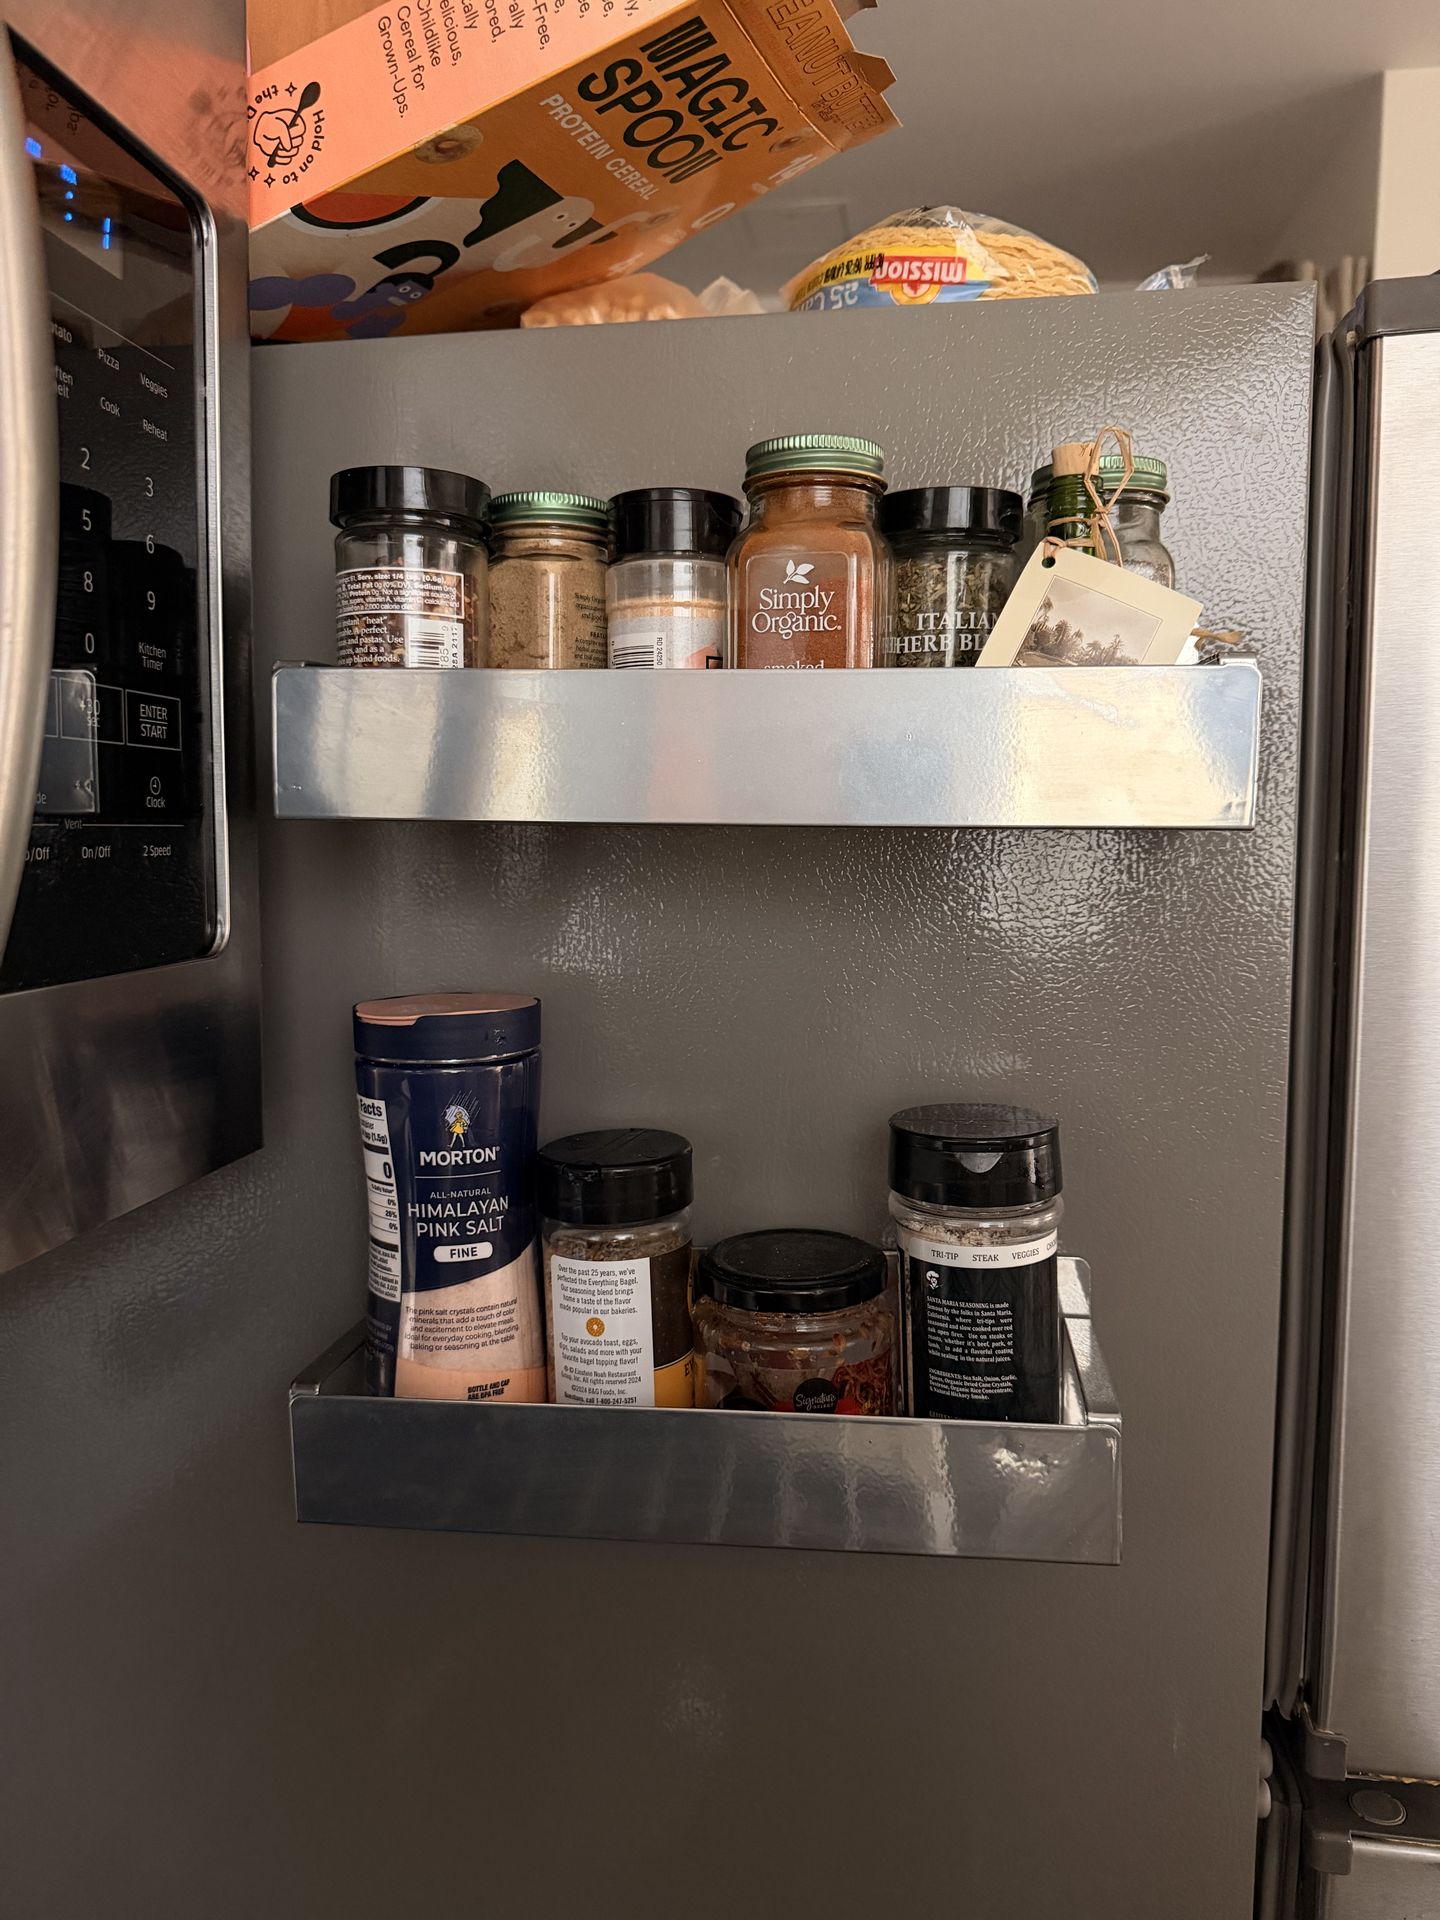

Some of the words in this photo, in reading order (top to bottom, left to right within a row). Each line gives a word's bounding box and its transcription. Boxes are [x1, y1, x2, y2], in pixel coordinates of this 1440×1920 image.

[461, 0, 478, 31] ally
[484, 0, 506, 44] ored,
[508, 0, 524, 31] ally
[416, 0, 442, 68] Childlike
[440, 0, 463, 67] elicious,
[397, 5, 422, 63] Cereal
[410, 63, 426, 92] for
[766, 0, 851, 86] EANUT
[378, 15, 409, 119] Grown-Ups.
[639, 15, 778, 151] MAGIC
[254, 84, 279, 105] the
[577, 58, 723, 184] SPOON
[311, 109, 326, 152] Hold
[539, 93, 615, 160] PROTEIN
[605, 157, 660, 201] CEREAL
[299, 154, 314, 173] on
[282, 171, 299, 185] to
[831, 281, 859, 310] 25
[97, 347, 120, 371] Pizza
[57, 383, 70, 399] elt
[139, 371, 168, 399] Veggies
[100, 396, 121, 417] Cook
[142, 418, 168, 442] Reheat
[80, 447, 91, 471] 2
[145, 476, 154, 497] 3
[82, 508, 92, 531] 5
[146, 533, 155, 554] 6
[84, 570, 94, 592] 8
[147, 590, 156, 611] 9
[758, 584, 835, 616] Simply
[361, 625, 388, 636] perfect
[751, 610, 843, 640] Organic.
[85, 632, 95, 654] 0
[359, 636, 385, 647] pastas.
[387, 634, 404, 644] Use
[656, 636, 663, 647] RD
[896, 633, 953, 653] HERB
[138, 641, 167, 660] Kitchen
[353, 655, 373, 664] bland
[374, 654, 401, 664] foods.
[142, 655, 164, 672] Timer
[139, 703, 168, 721] ENTER
[140, 723, 168, 739] START
[146, 796, 166, 809] Clock
[64, 817, 83, 830] Vent
[81, 845, 111, 859] On/Off
[142, 844, 149, 857] 2
[150, 844, 172, 858] Speed
[419, 1146, 497, 1167] MORTON
[382, 1161, 392, 1179] 0
[429, 1187, 492, 1199] ALL-NATURAL
[407, 1195, 509, 1219] HIMALAYAN
[416, 1221, 461, 1238] PINK
[466, 1215, 505, 1236] SALT
[449, 1246, 479, 1259] FINE
[930, 1249, 959, 1261] TRI-TIP
[972, 1254, 1000, 1262] STEAK
[1011, 1247, 1040, 1260] VEGGIES
[569, 1267, 577, 1275] the
[578, 1269, 590, 1277] past
[591, 1268, 599, 1277] 25
[599, 1269, 618, 1278] years,
[618, 1267, 636, 1276] we've
[578, 1278, 587, 1286] the
[588, 1278, 619, 1287] Everything
[619, 1276, 639, 1287] Bagel.
[560, 1283, 569, 1292] Our
[569, 1286, 596, 1297] seasoning
[596, 1288, 613, 1296] blend
[614, 1287, 634, 1297] brings
[405, 1305, 417, 1315] The
[418, 1307, 434, 1317] pink
[435, 1307, 448, 1316] salt
[449, 1306, 475, 1317] crystals
[476, 1302, 500, 1313] contain
[500, 1296, 518, 1308] natural
[581, 1297, 595, 1305] taste
[596, 1297, 603, 1305] of
[603, 1297, 614, 1306] the
[614, 1297, 631, 1305] flavor
[959, 1301, 990, 1309] SEASONING
[409, 1315, 439, 1325] minerals
[440, 1316, 454, 1324] that
[455, 1315, 470, 1324] add
[476, 1312, 495, 1322] touch
[495, 1310, 502, 1318] of
[502, 1307, 516, 1317] color
[572, 1306, 592, 1315] popular
[611, 1306, 638, 1316] bakeries.
[955, 1316, 972, 1324] where
[410, 1325, 423, 1333] and
[424, 1325, 464, 1333] excitement
[465, 1324, 473, 1332] to
[473, 1321, 497, 1331] elevate
[410, 1342, 434, 1352] baking
[444, 1340, 480, 1351] seasoning
[481, 1339, 488, 1347] at
[489, 1337, 500, 1346] the
[421, 1333, 433, 1342] for
[432, 1334, 464, 1344] everyday
[580, 1338, 603, 1346] avocado
[603, 1338, 621, 1347] toast,
[622, 1338, 639, 1347] eggs,
[587, 1348, 599, 1356] and
[615, 1348, 629, 1356] with
[629, 1347, 642, 1356] your
[579, 1356, 595, 1365] bagel
[595, 1358, 618, 1367] topping
[619, 1356, 639, 1365] flavor!
[589, 1377, 605, 1386] rights
[605, 1377, 628, 1386] reserved
[628, 1375, 642, 1384] 2024
[593, 1370, 607, 1378] Noah
[607, 1369, 637, 1378] Restaurant
[467, 1383, 489, 1393] BOTTLE
[489, 1381, 500, 1389] AND
[501, 1378, 511, 1387] CAP
[492, 1387, 505, 1396] FREE
[795, 1392, 837, 1412] Signature
